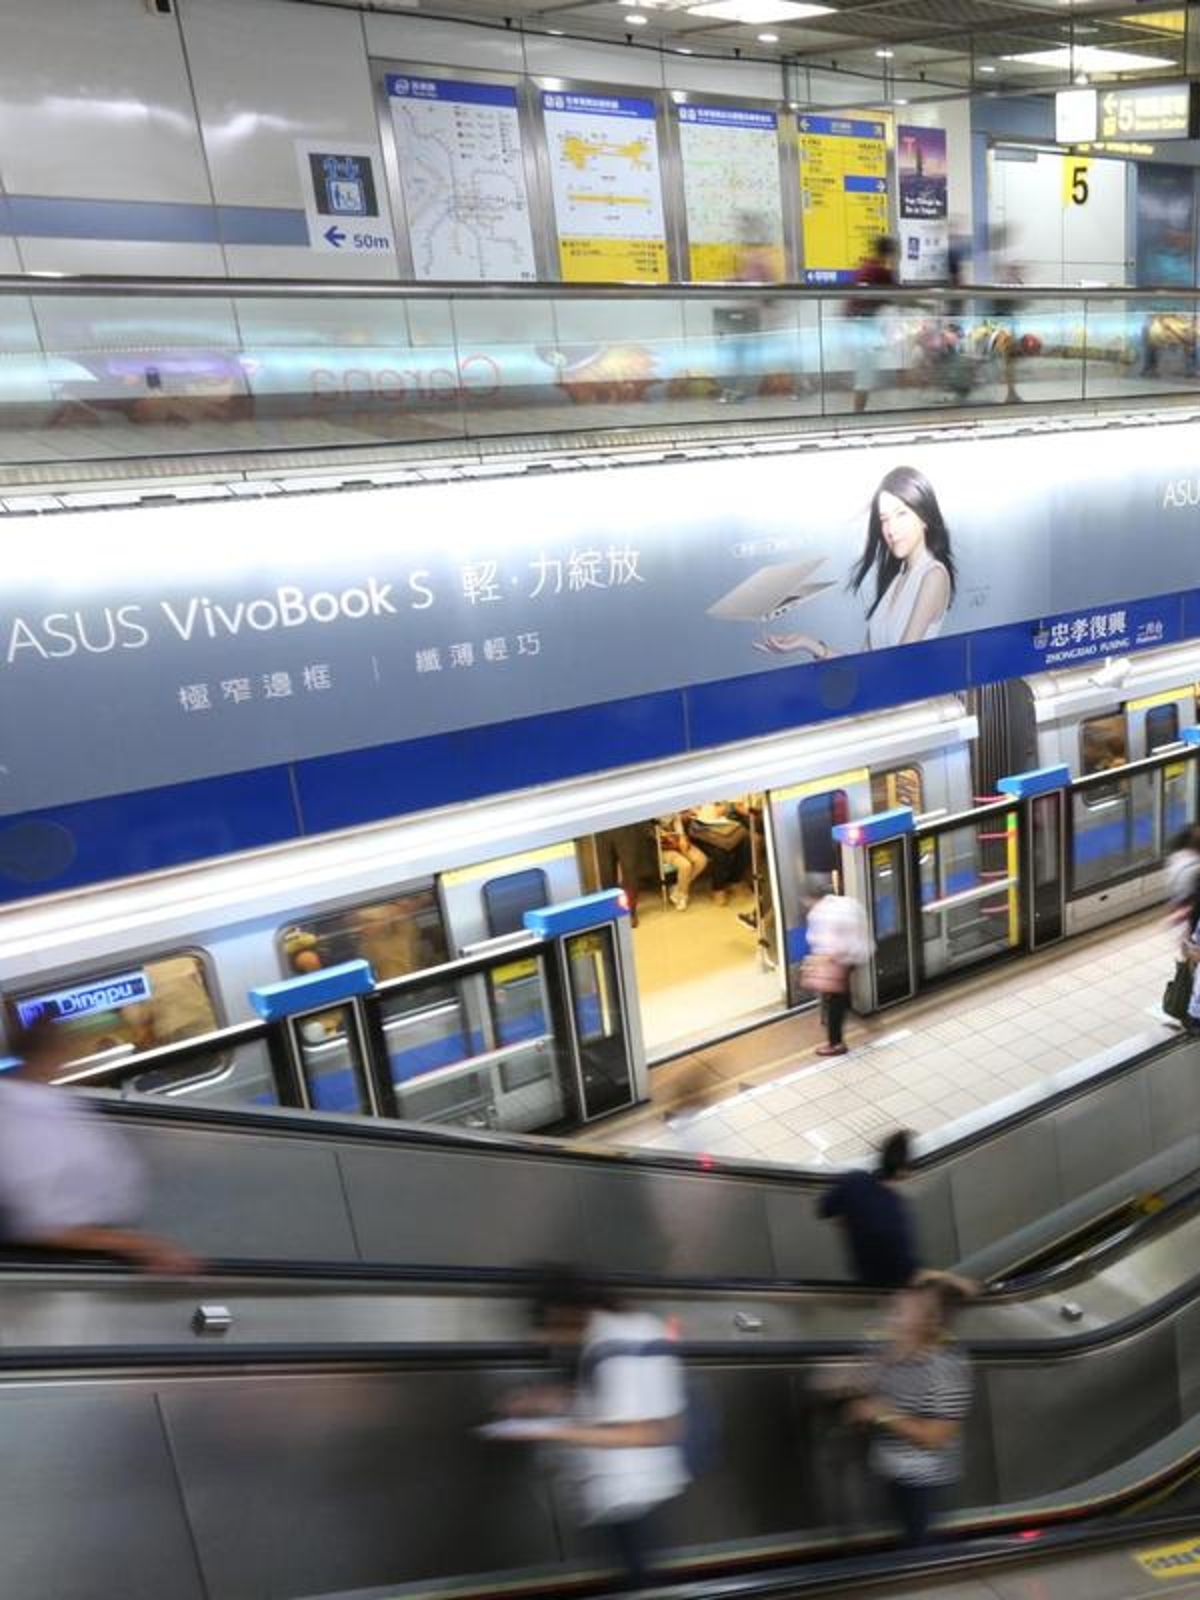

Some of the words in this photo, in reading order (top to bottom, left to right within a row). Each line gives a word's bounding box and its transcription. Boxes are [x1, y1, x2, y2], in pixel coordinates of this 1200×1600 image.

[1119, 99, 1134, 131] 5
[1072, 167, 1089, 205] 5
[353, 233, 389, 249] 50m
[6, 604, 149, 663] ASUS
[160, 576, 397, 642] VivoBook
[410, 570, 435, 610] S
[1050, 610, 1127, 648] 忠孝復興
[179, 663, 334, 713] 極窄邊框
[414, 631, 542, 673] 纖薄輕巧
[57, 981, 133, 1014] Dingpu
